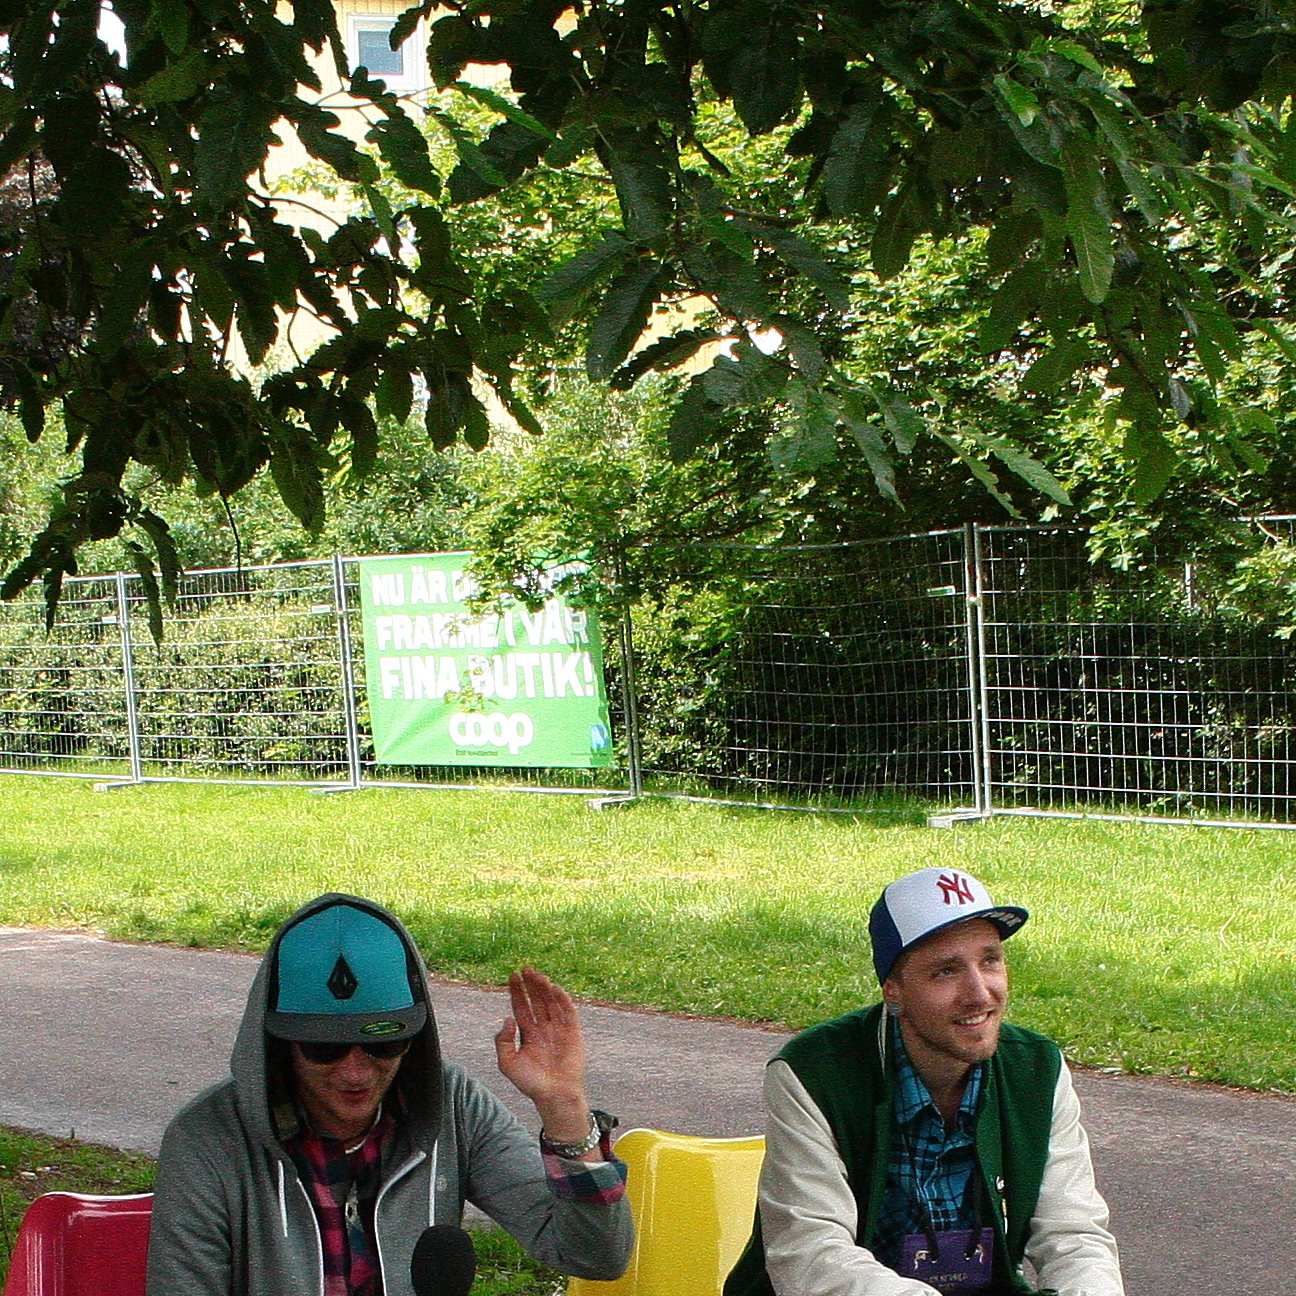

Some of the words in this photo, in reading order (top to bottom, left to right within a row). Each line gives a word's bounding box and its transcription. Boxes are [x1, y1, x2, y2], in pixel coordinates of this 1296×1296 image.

[371, 573, 405, 606] NU
[410, 565, 449, 604] ÄR
[451, 570, 479, 602] D
[375, 612, 500, 650] FRAMME
[504, 610, 517, 646] I
[519, 598, 590, 645] VÅR
[379, 655, 461, 700] FINA
[467, 652, 595, 700] BUTIK!
[448, 711, 535, 755] coop
[936, 873, 975, 905] NY
